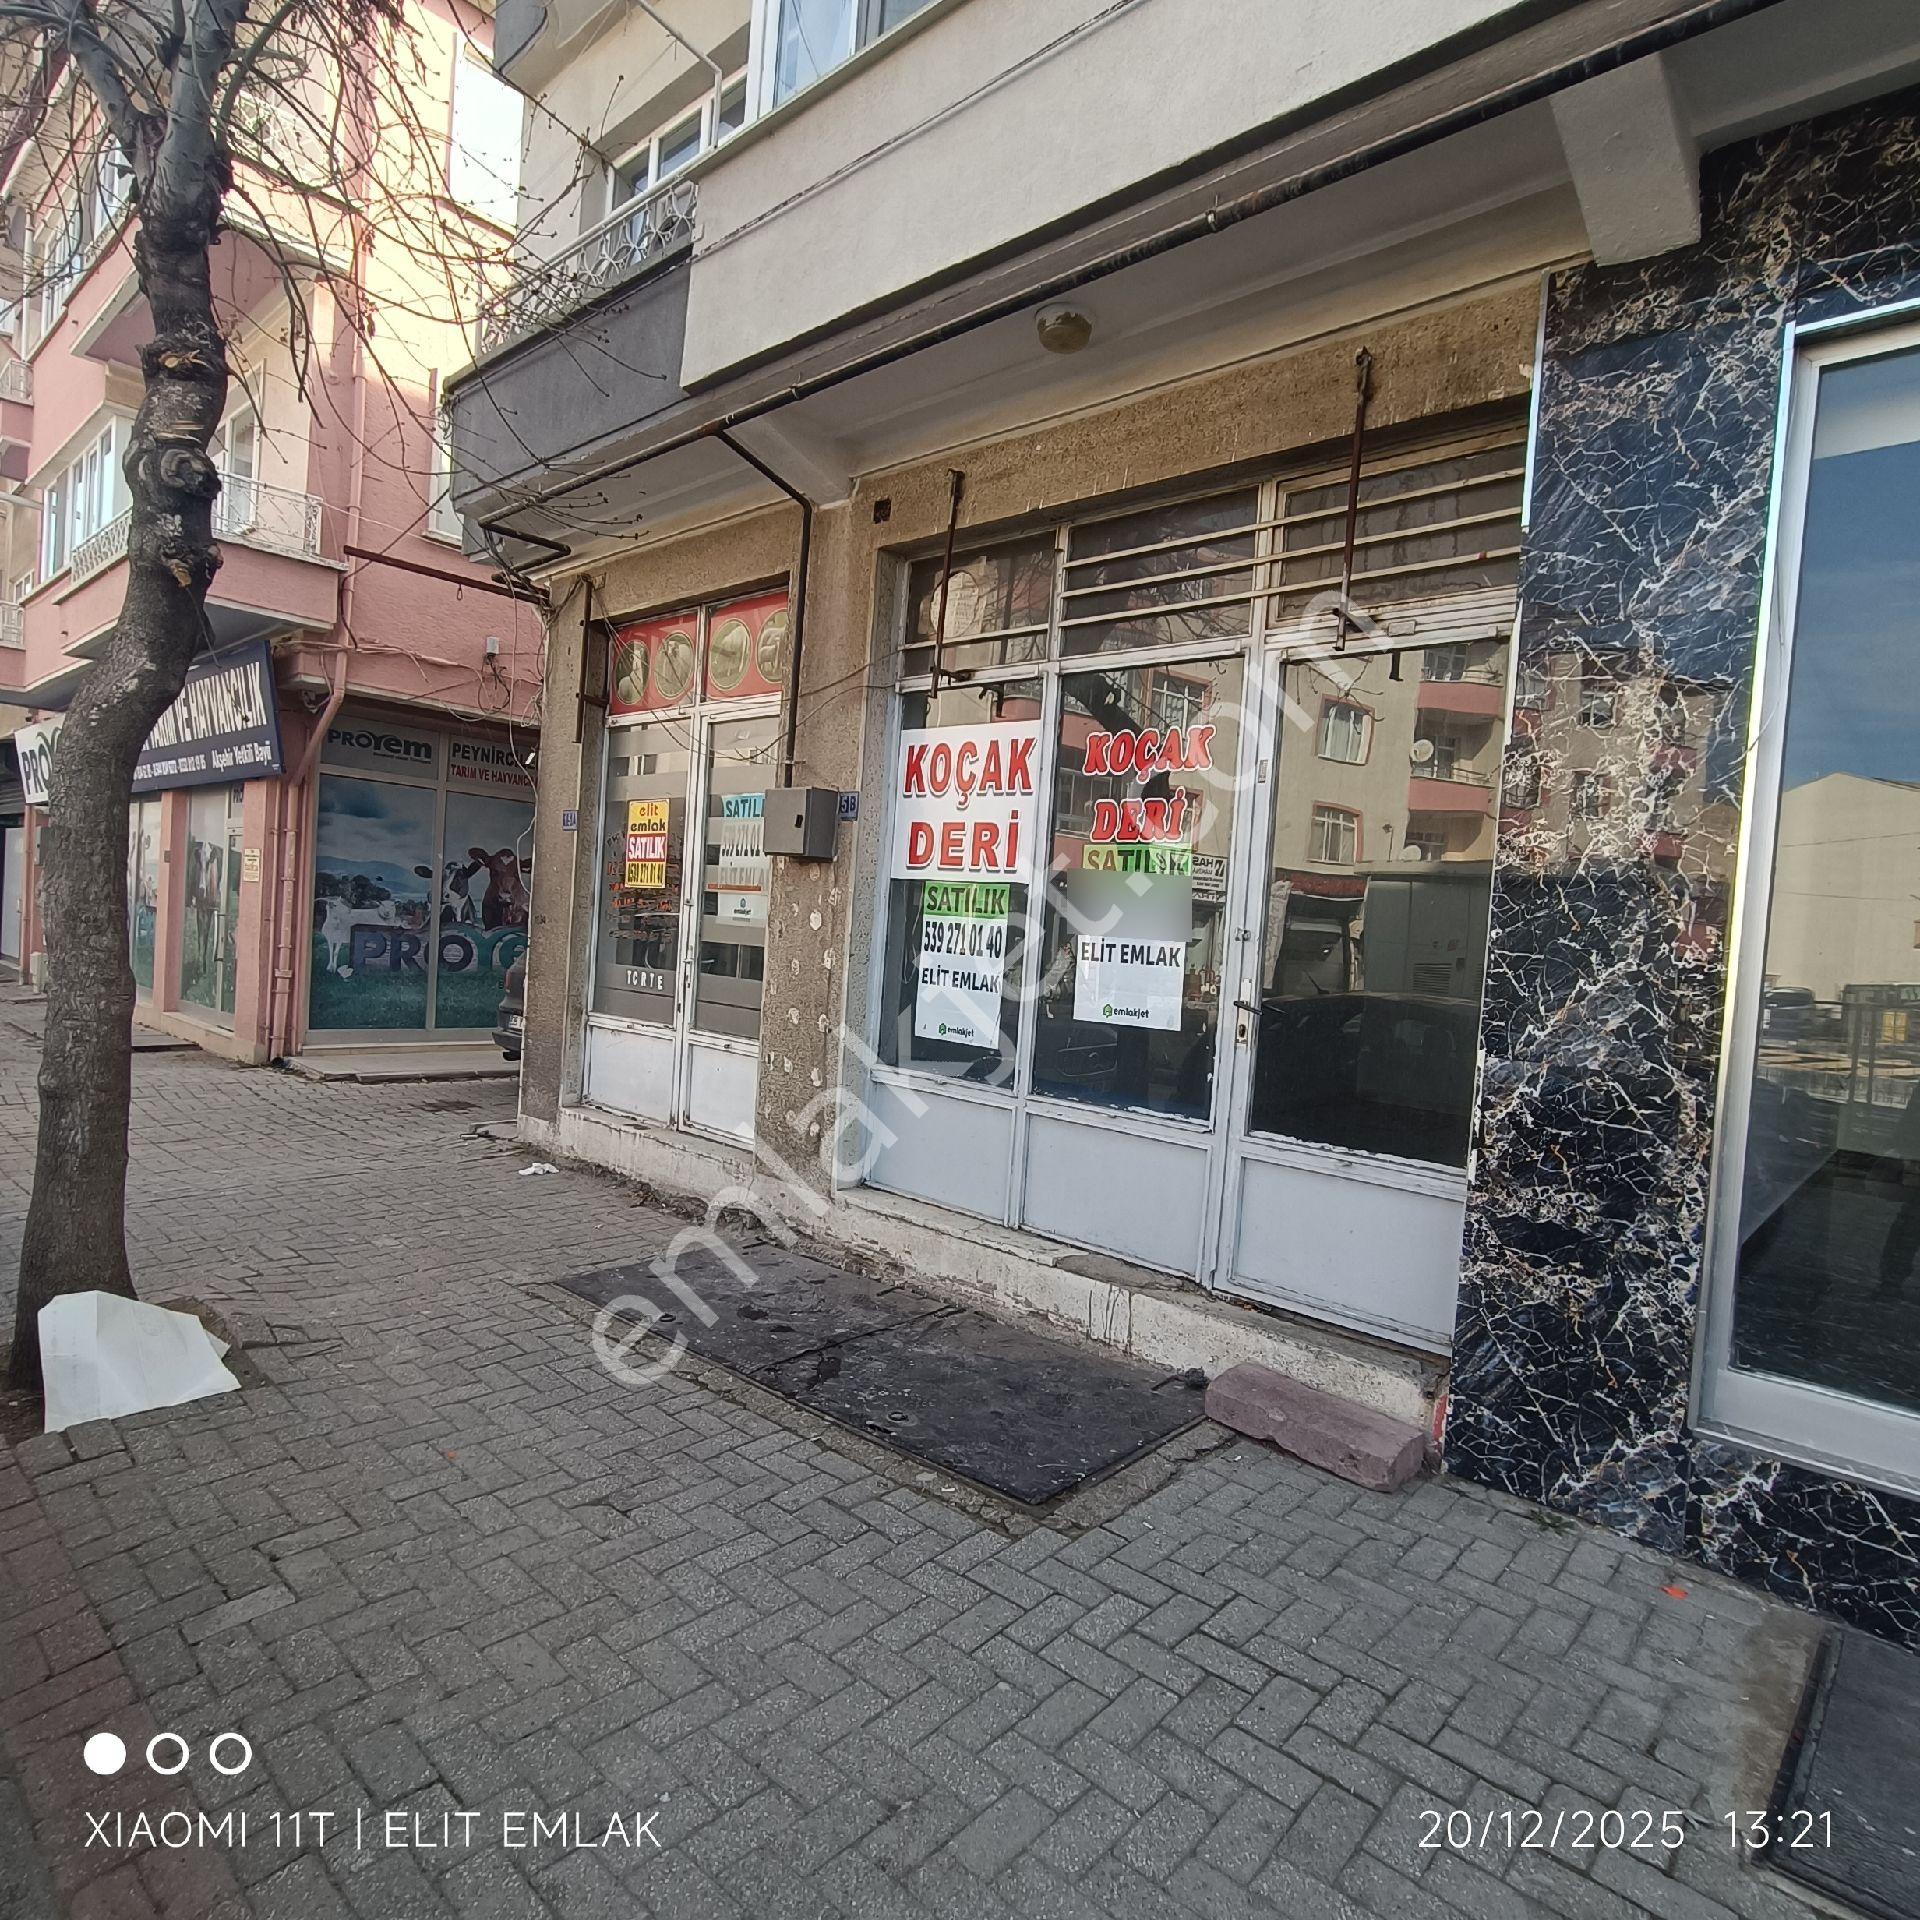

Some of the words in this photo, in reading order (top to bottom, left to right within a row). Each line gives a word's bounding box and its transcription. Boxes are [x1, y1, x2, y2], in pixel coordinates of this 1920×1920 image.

[1083, 725, 1215, 783] KOÇAK
[904, 738, 1037, 808] KOÇAK
[639, 803, 659, 816] elit
[725, 798, 766, 817] SATIL
[1090, 786, 1187, 842] DERİ
[631, 818, 666, 831] emlak
[629, 836, 665, 859] SATILIK
[907, 810, 1021, 869] DERİ
[927, 886, 1006, 915] SATILIK
[924, 921, 944, 953] 539
[946, 923, 966, 956] 271
[969, 924, 983, 957] 01
[986, 926, 1002, 959] 40
[1081, 938, 1116, 963] ELİT
[1120, 944, 1181, 968] EMLAK
[922, 965, 949, 987] ELİT
[951, 971, 1000, 994] EMLAK
[1114, 1007, 1150, 1020] emlakjet
